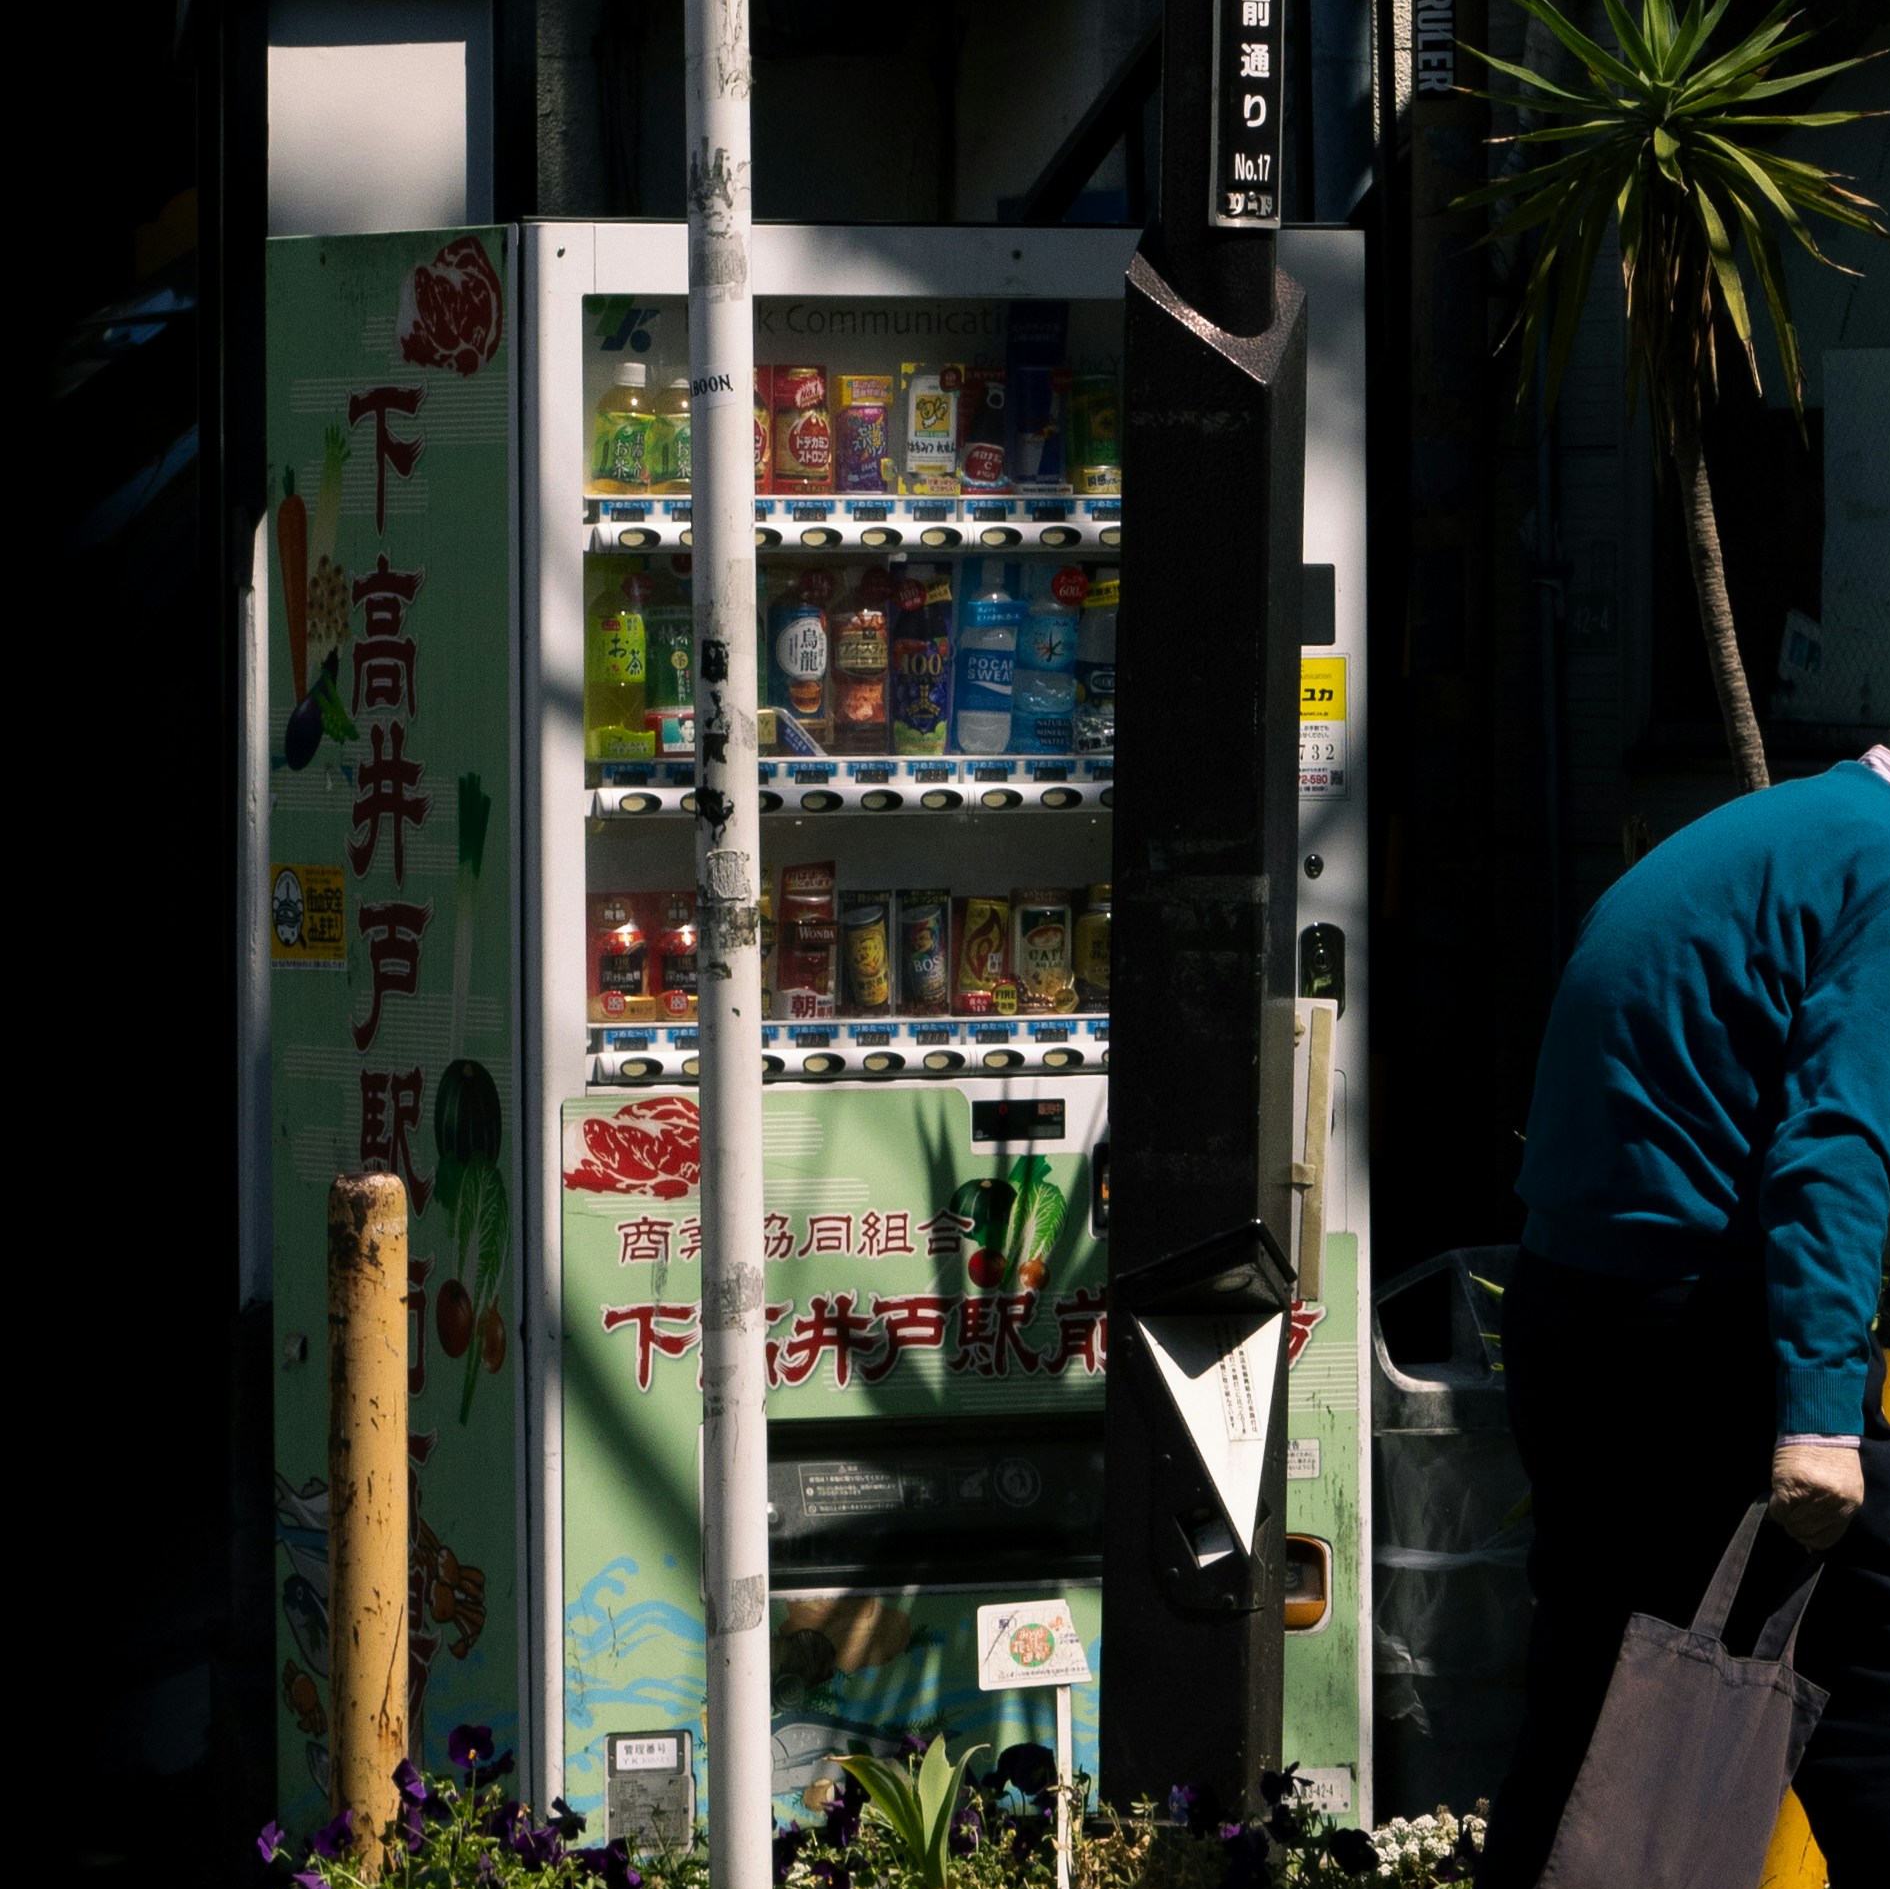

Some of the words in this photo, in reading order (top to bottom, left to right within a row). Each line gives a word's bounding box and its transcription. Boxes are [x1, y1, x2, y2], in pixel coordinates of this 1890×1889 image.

[1234, 152, 1271, 183] No.17
[1299, 774, 1329, 786] 2-590
[799, 926, 836, 941] WONDA
